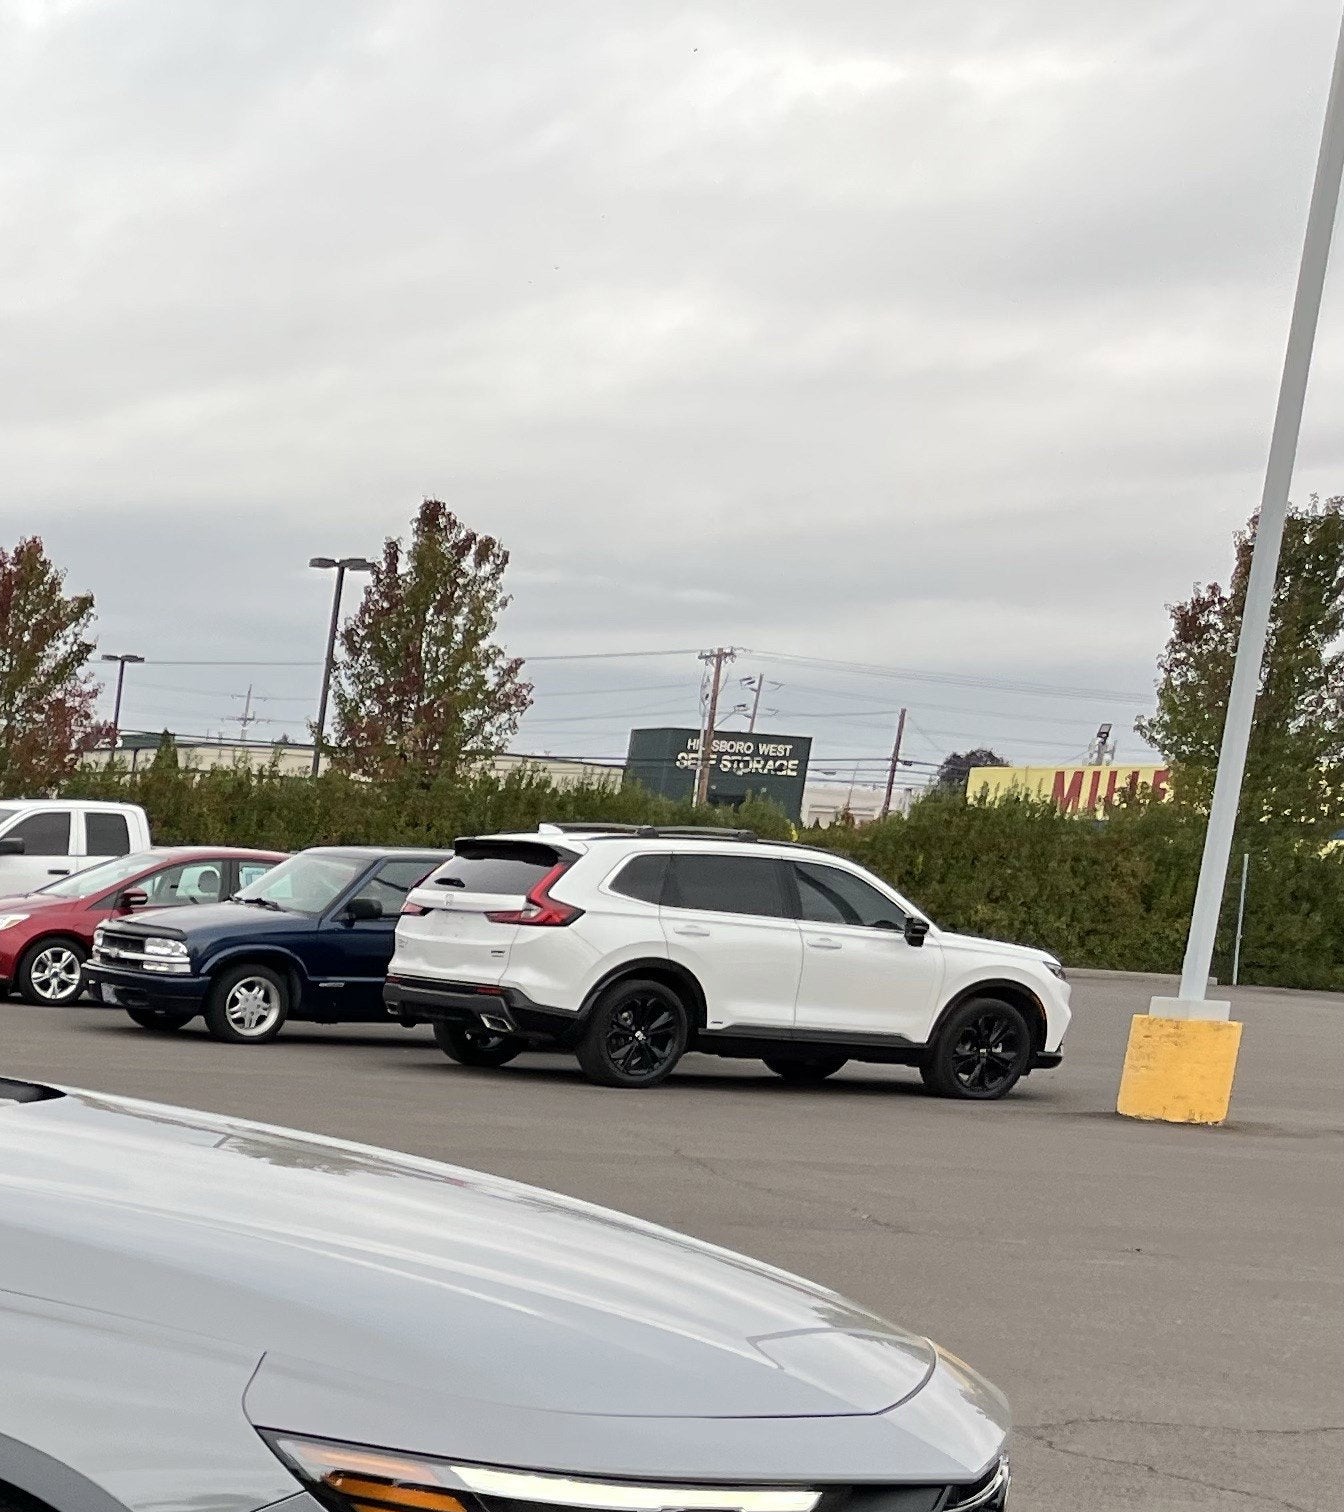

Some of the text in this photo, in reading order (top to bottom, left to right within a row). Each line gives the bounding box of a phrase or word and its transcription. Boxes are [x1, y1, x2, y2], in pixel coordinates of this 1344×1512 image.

[687, 738, 793, 757] HISBORO WEST
[675, 752, 799, 776] SEF STORAGE
